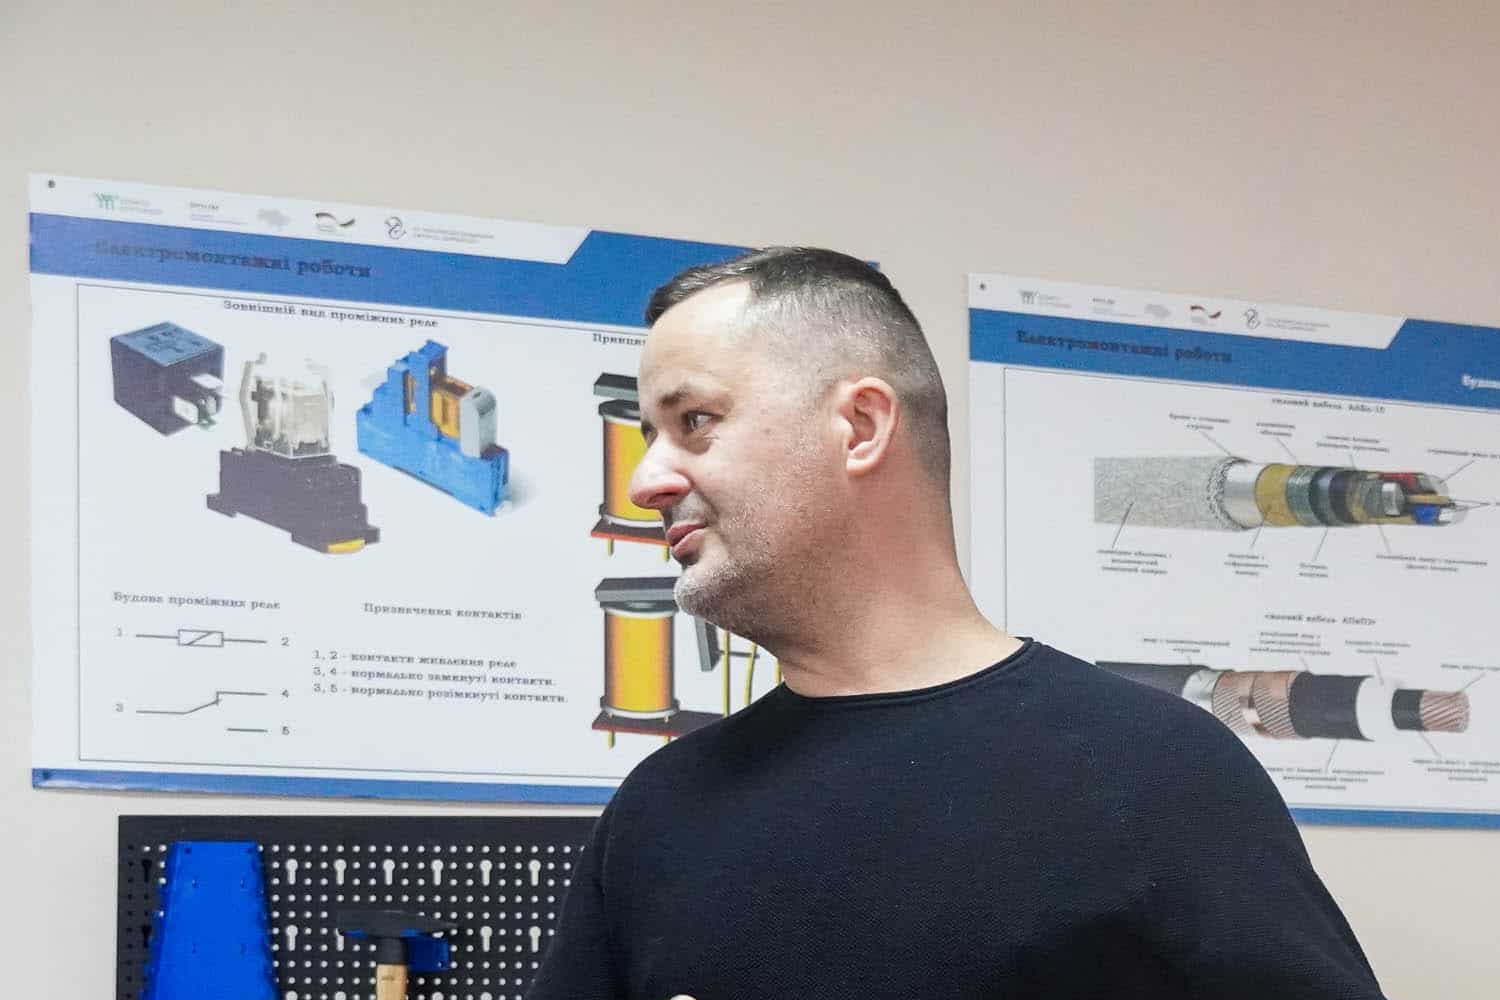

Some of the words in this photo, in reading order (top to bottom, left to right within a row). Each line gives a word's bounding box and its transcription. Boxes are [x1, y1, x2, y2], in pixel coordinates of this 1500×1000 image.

[296, 258, 371, 278] роботи
[223, 300, 297, 316] Зовнішній
[330, 311, 404, 326] проміжних
[409, 318, 439, 328] реле
[250, 601, 281, 611] реле
[456, 608, 522, 620] контактів
[281, 637, 290, 647] 2
[351, 654, 415, 663] контакти
[488, 659, 518, 670] реле
[351, 670, 424, 680] нормально
[281, 689, 290, 699] 4
[351, 687, 424, 697] нормально
[281, 726, 290, 736] 5
